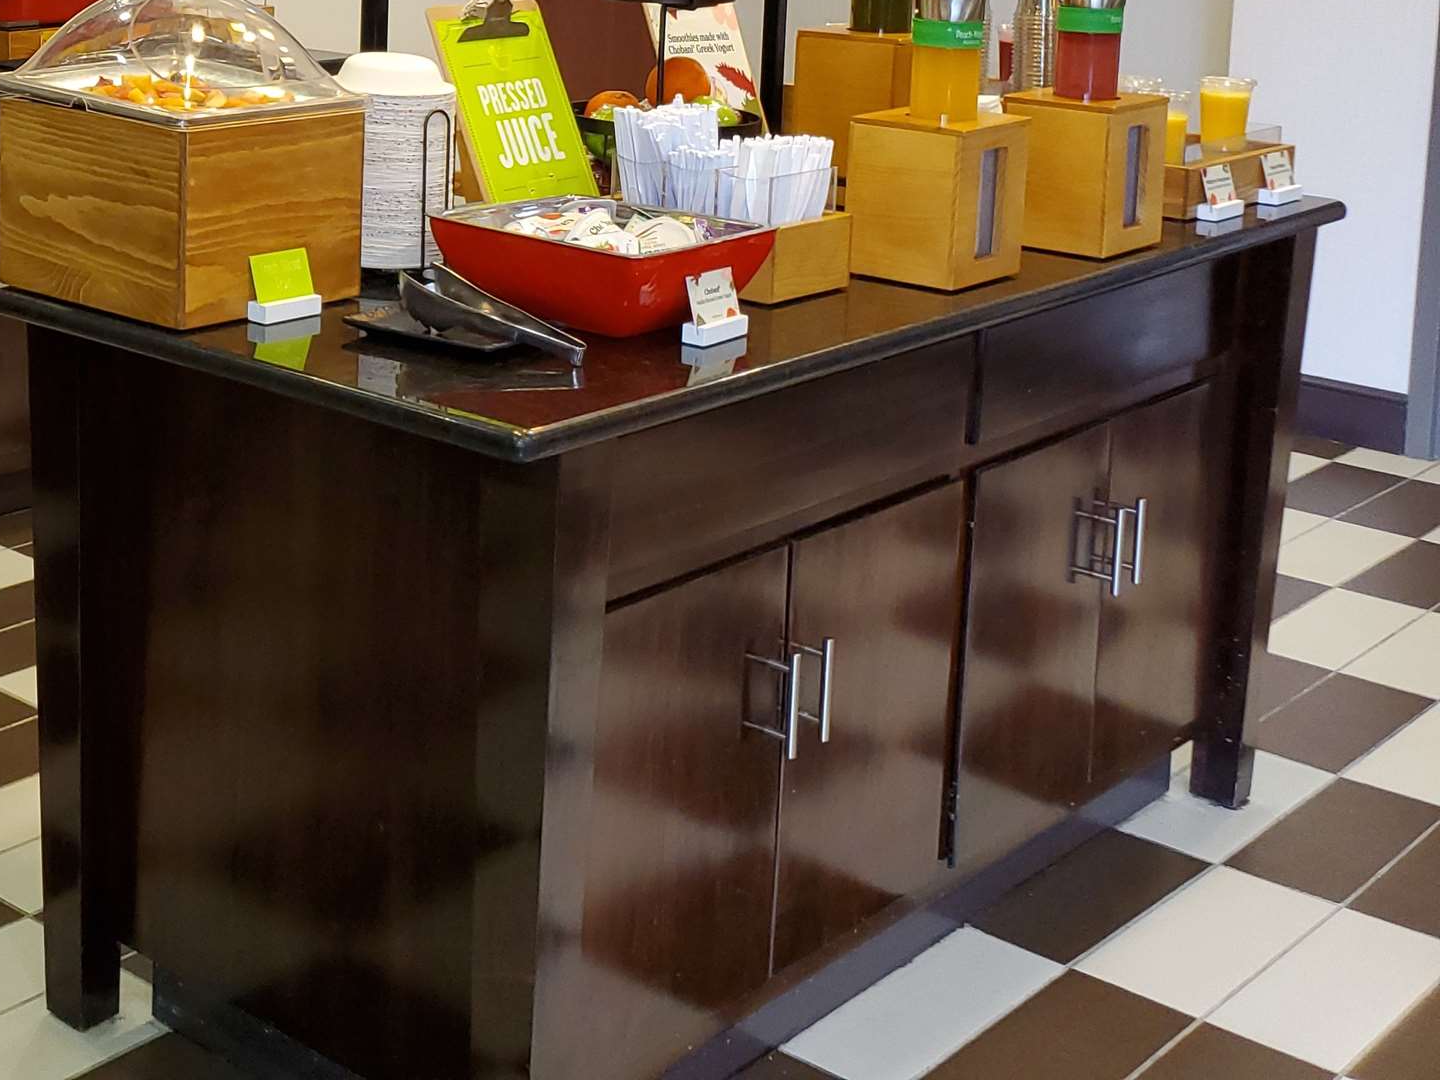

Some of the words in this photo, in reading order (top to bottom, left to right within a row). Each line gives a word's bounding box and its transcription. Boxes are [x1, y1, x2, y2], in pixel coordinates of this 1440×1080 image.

[667, 31, 699, 43] Smoothies
[699, 31, 716, 42] made
[716, 31, 730, 41] with
[696, 43, 715, 53] Greek
[715, 43, 735, 54] Yogurt
[477, 77, 548, 116] PRESSED
[495, 112, 567, 169] JUICE
